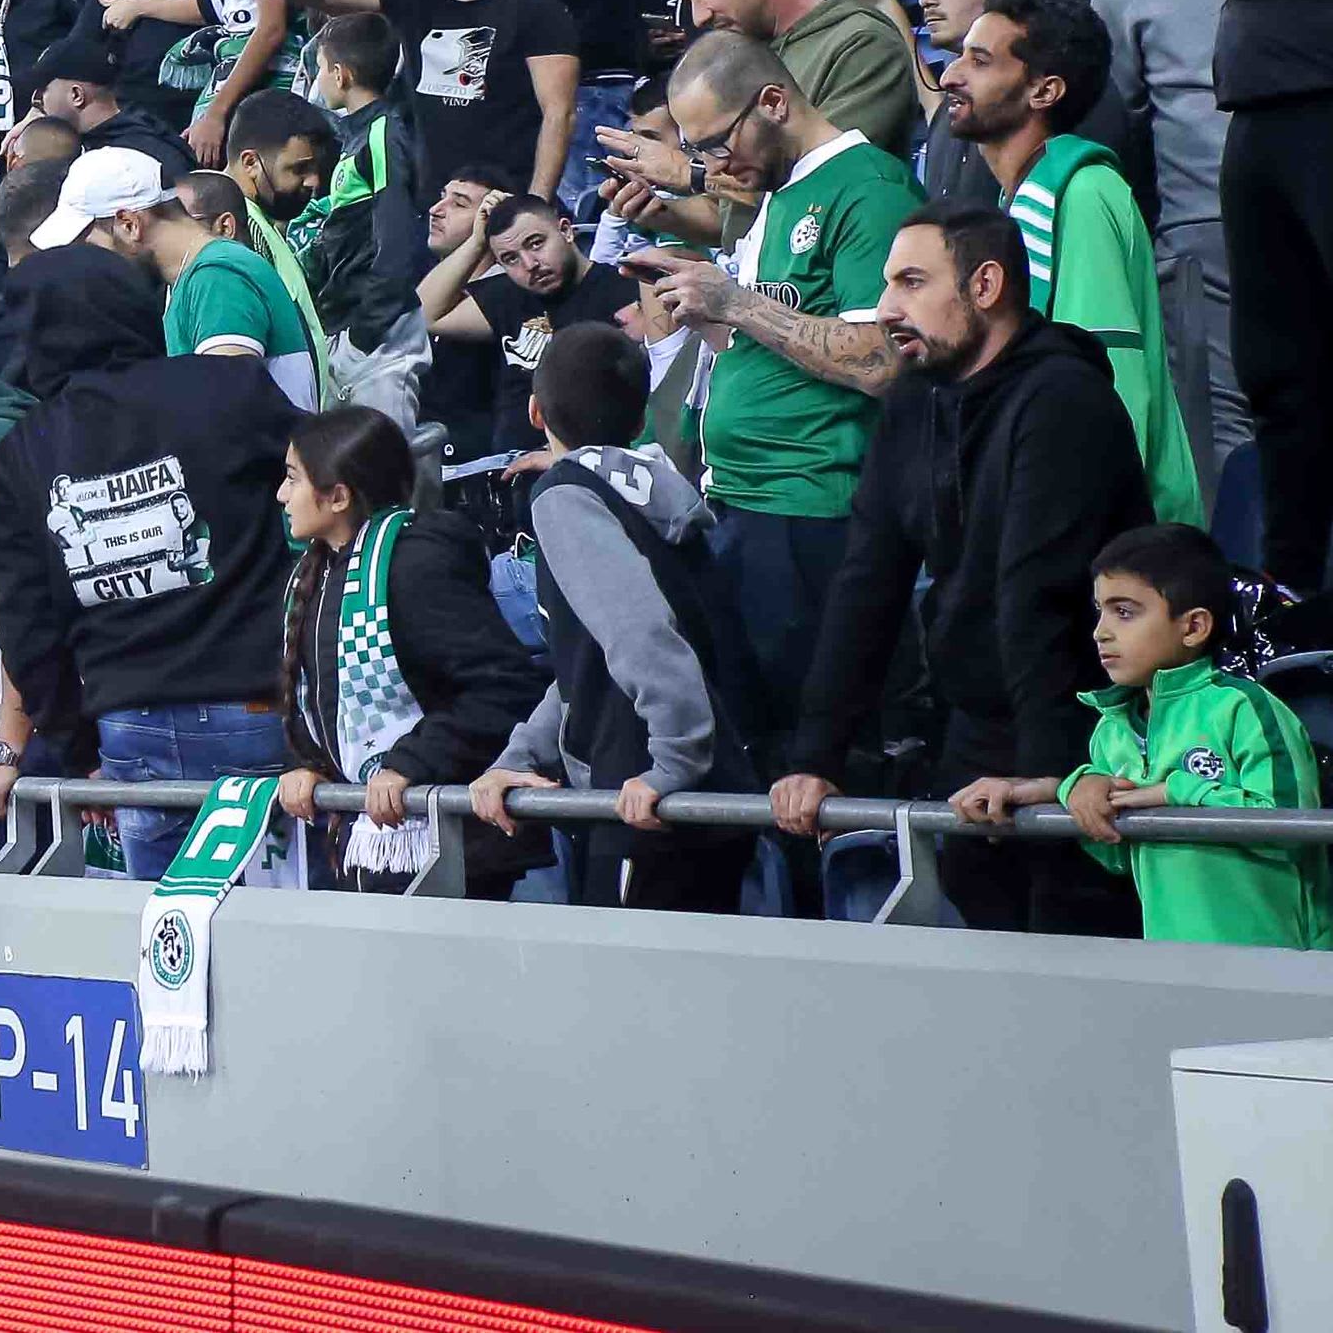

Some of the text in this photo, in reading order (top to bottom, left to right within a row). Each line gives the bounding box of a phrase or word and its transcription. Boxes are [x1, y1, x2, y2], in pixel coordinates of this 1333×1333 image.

[107, 463, 176, 503] HAIFA
[103, 526, 164, 550] THIS IS OUR
[93, 567, 155, 602] CITY
